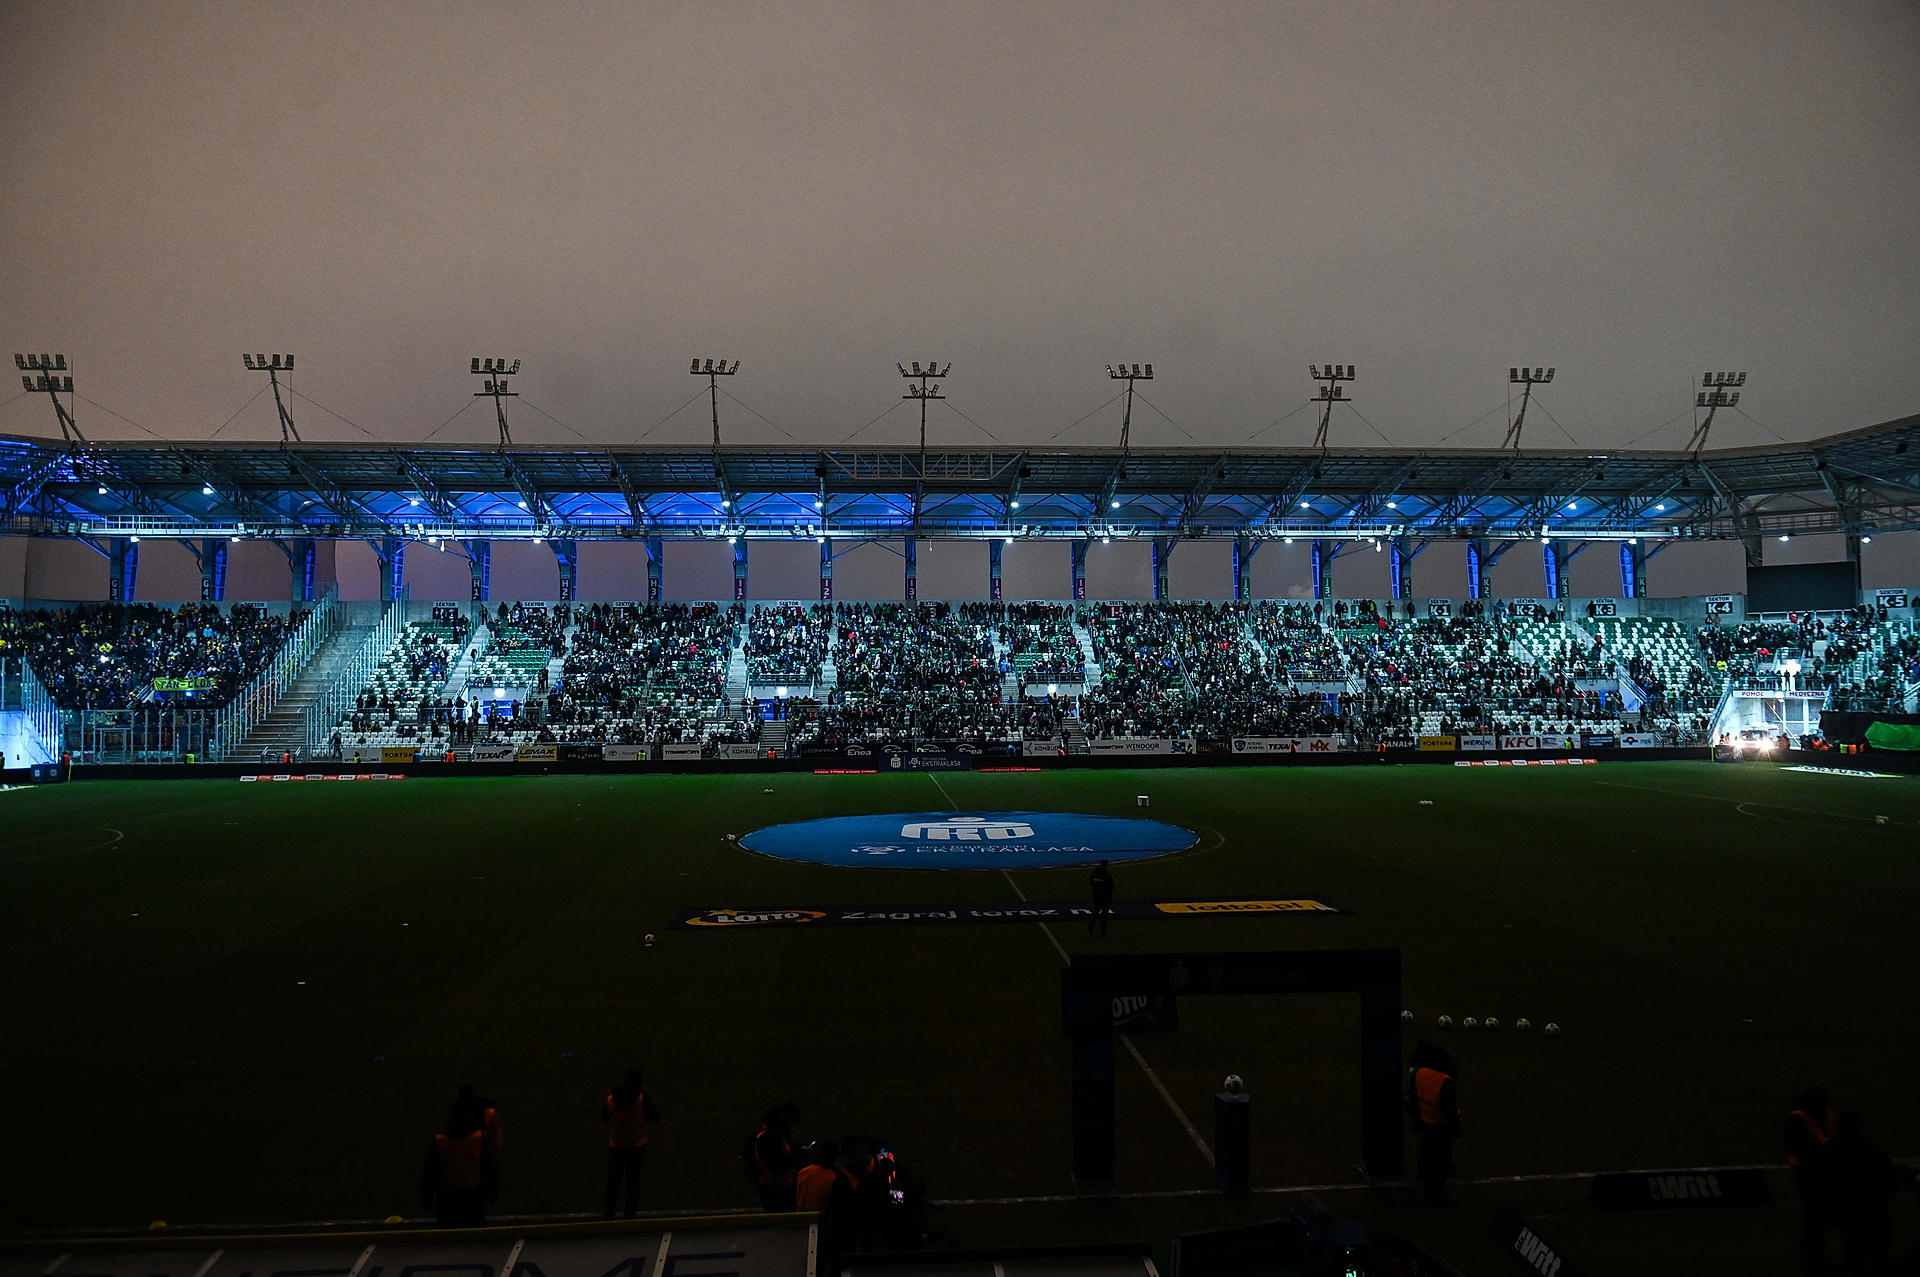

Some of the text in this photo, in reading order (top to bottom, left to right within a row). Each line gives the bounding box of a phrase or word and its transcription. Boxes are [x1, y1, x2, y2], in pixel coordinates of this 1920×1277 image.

[1879, 596, 1904, 607] K-5
[1430, 605, 1449, 616] K-1
[1516, 605, 1535, 616] K-2
[1595, 605, 1614, 615] K-3
[1707, 603, 1731, 613] K-4
[1310, 739, 1329, 751] MAX
[1505, 736, 1534, 748] KFC
[1187, 901, 1304, 911] lotto.pl
[717, 912, 800, 923] LOTTO
[841, 909, 958, 921] Zagraj
